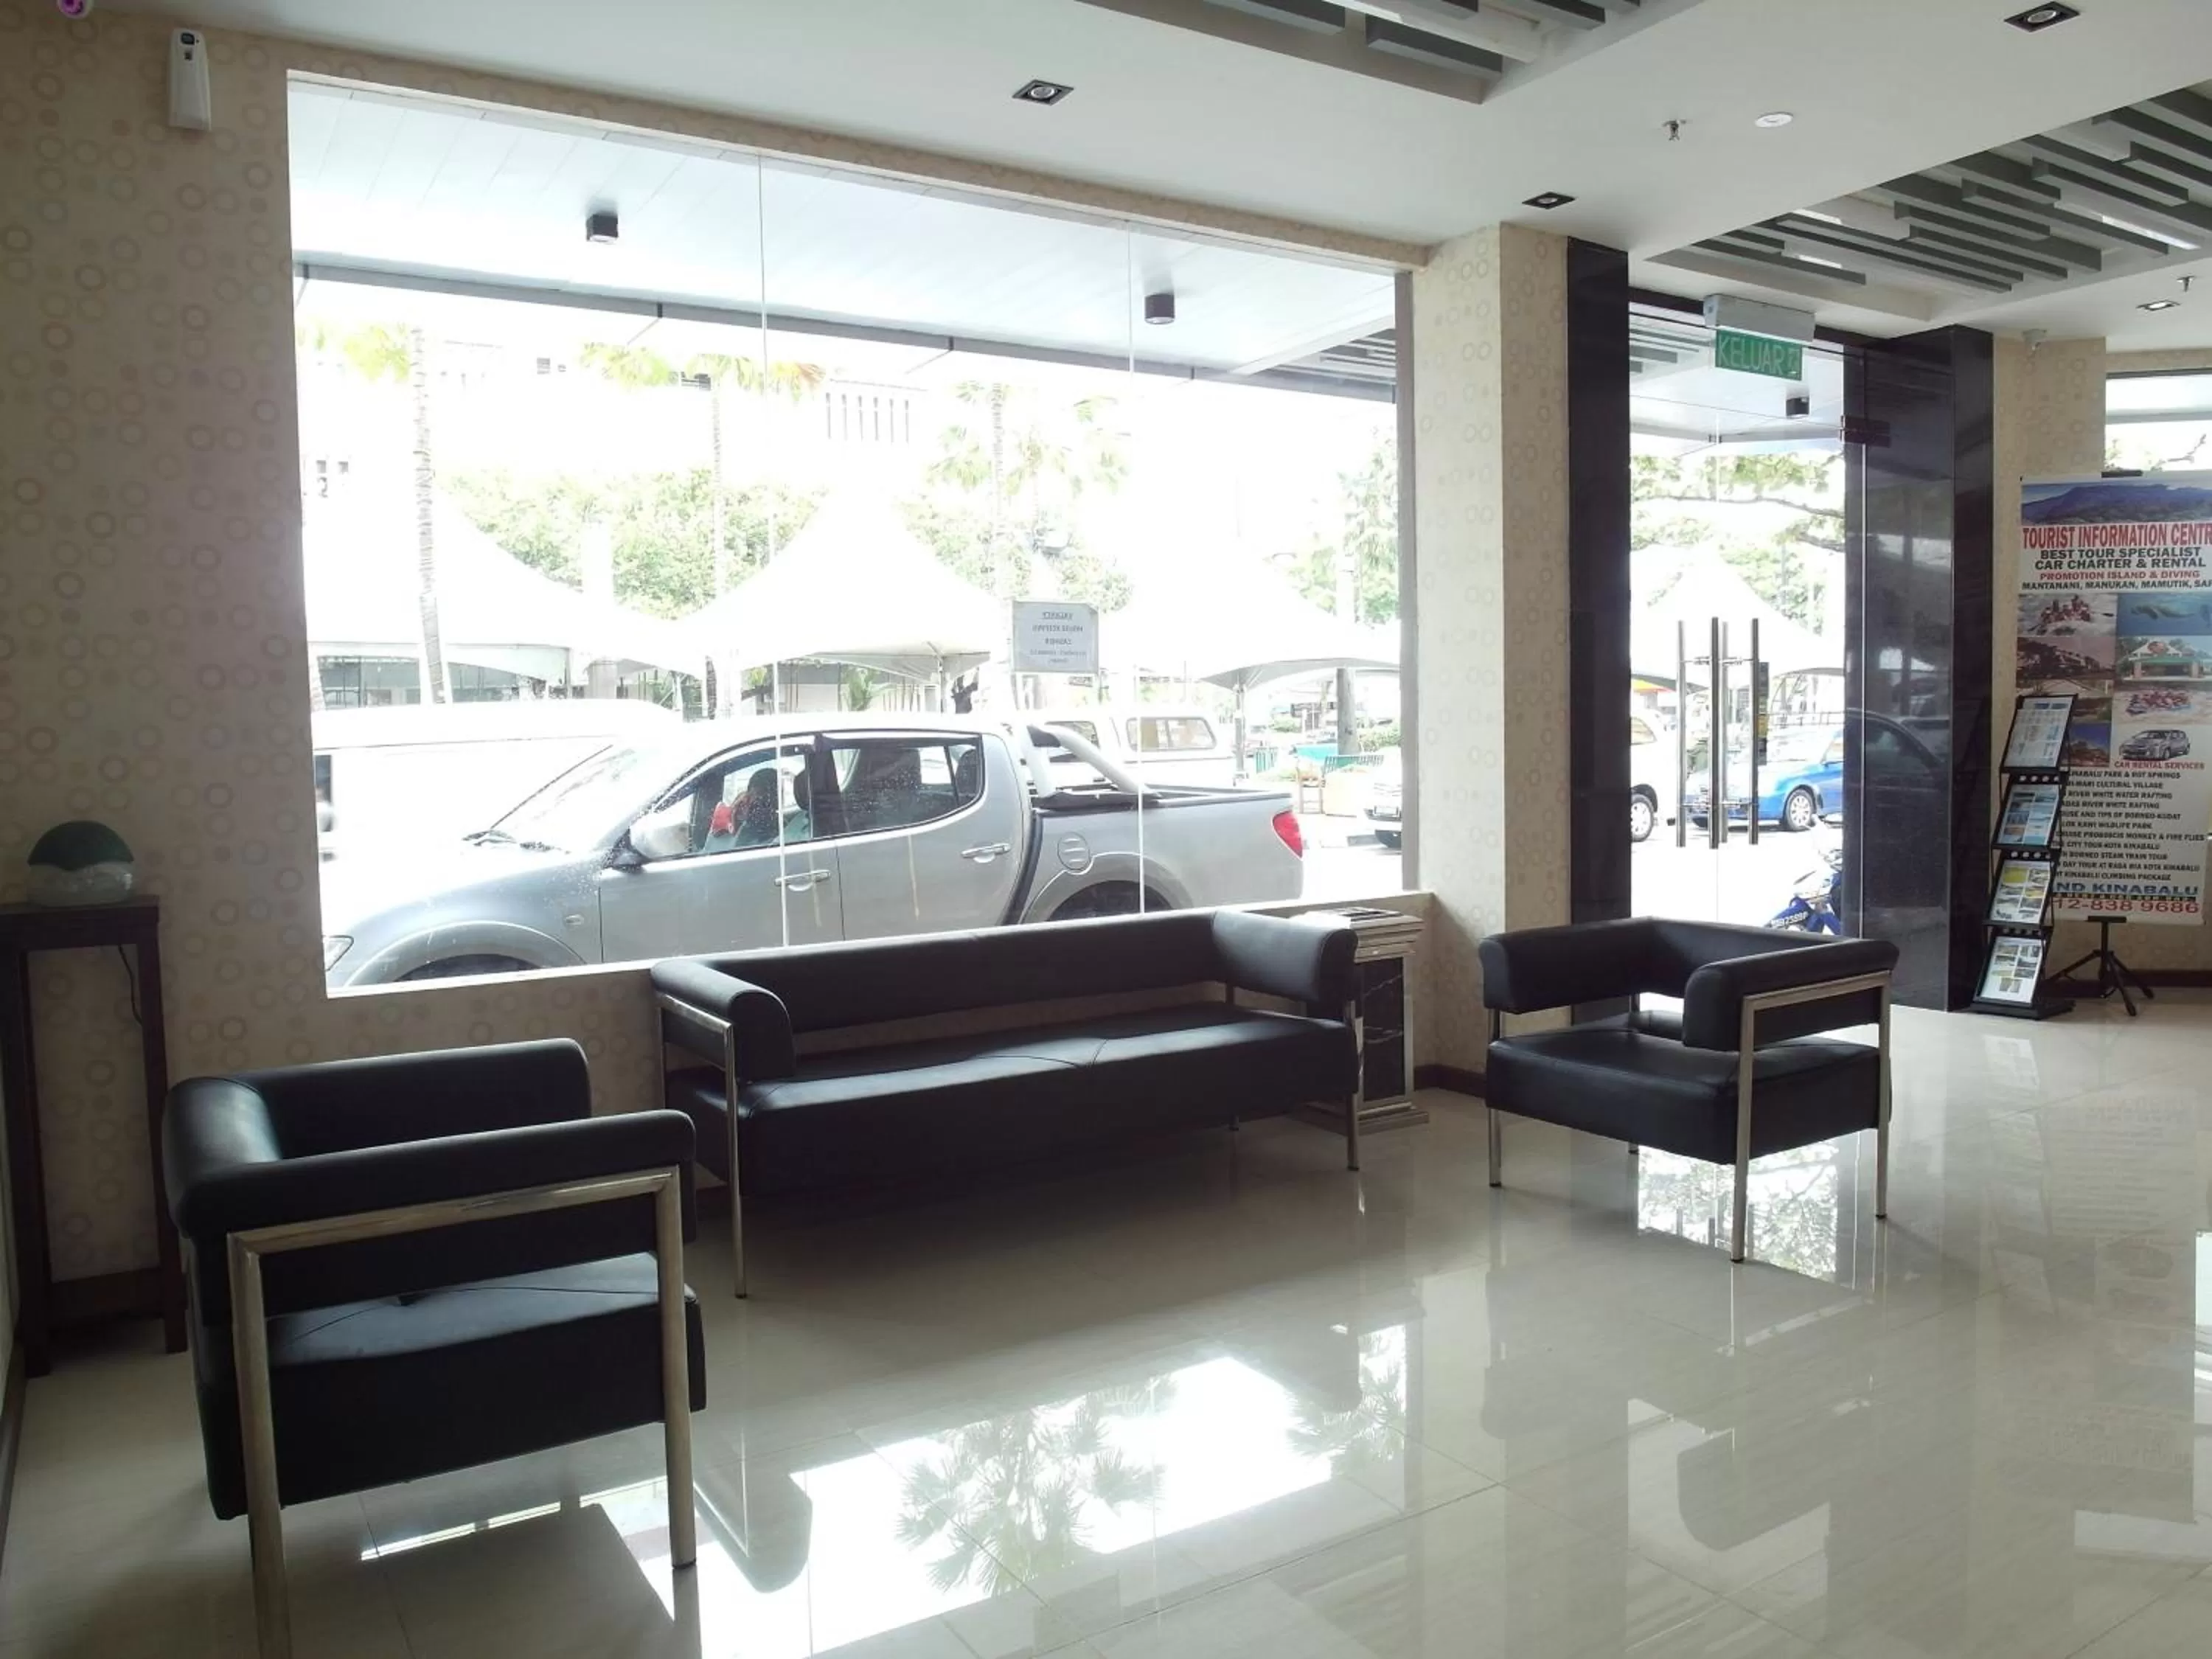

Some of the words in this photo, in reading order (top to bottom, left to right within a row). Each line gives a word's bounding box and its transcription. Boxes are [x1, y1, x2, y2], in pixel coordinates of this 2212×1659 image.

[1719, 334, 1784, 375] KELUAR
[2023, 526, 2076, 549] TOURIST
[2078, 524, 2167, 548] INFORMATION
[2040, 549, 2074, 560] BEST
[2078, 548, 2115, 558] TOUR
[2118, 546, 2201, 558] SPECIALIST
[2035, 560, 2063, 570] CAR
[2067, 559, 2132, 569] CHARTER
[2136, 558, 2147, 568] &
[2152, 557, 2206, 568] RENTAL
[2039, 571, 2104, 581] PROMOTION
[2107, 571, 2146, 580] ISLAND
[2149, 571, 2157, 579] &
[2160, 570, 2200, 579] DIVING
[2022, 581, 2083, 591] MANTANANI,
[2085, 580, 2138, 590] MANUKAN,
[2140, 580, 2193, 589] MAMUTIK,
[2114, 760, 2130, 768] CAR
[2132, 761, 2162, 769] RENTAL
[2164, 762, 2205, 770] SERVICES
[2141, 792, 2172, 800] RAFTING
[2098, 821, 2131, 830] WILDLIFE
[2163, 864, 2201, 872] KINABALU
[2138, 873, 2171, 881] PACKAGE
[2092, 883, 2199, 895] KINABALU
[2053, 898, 2133, 911] 12-838
[2140, 901, 2199, 914] 9686
